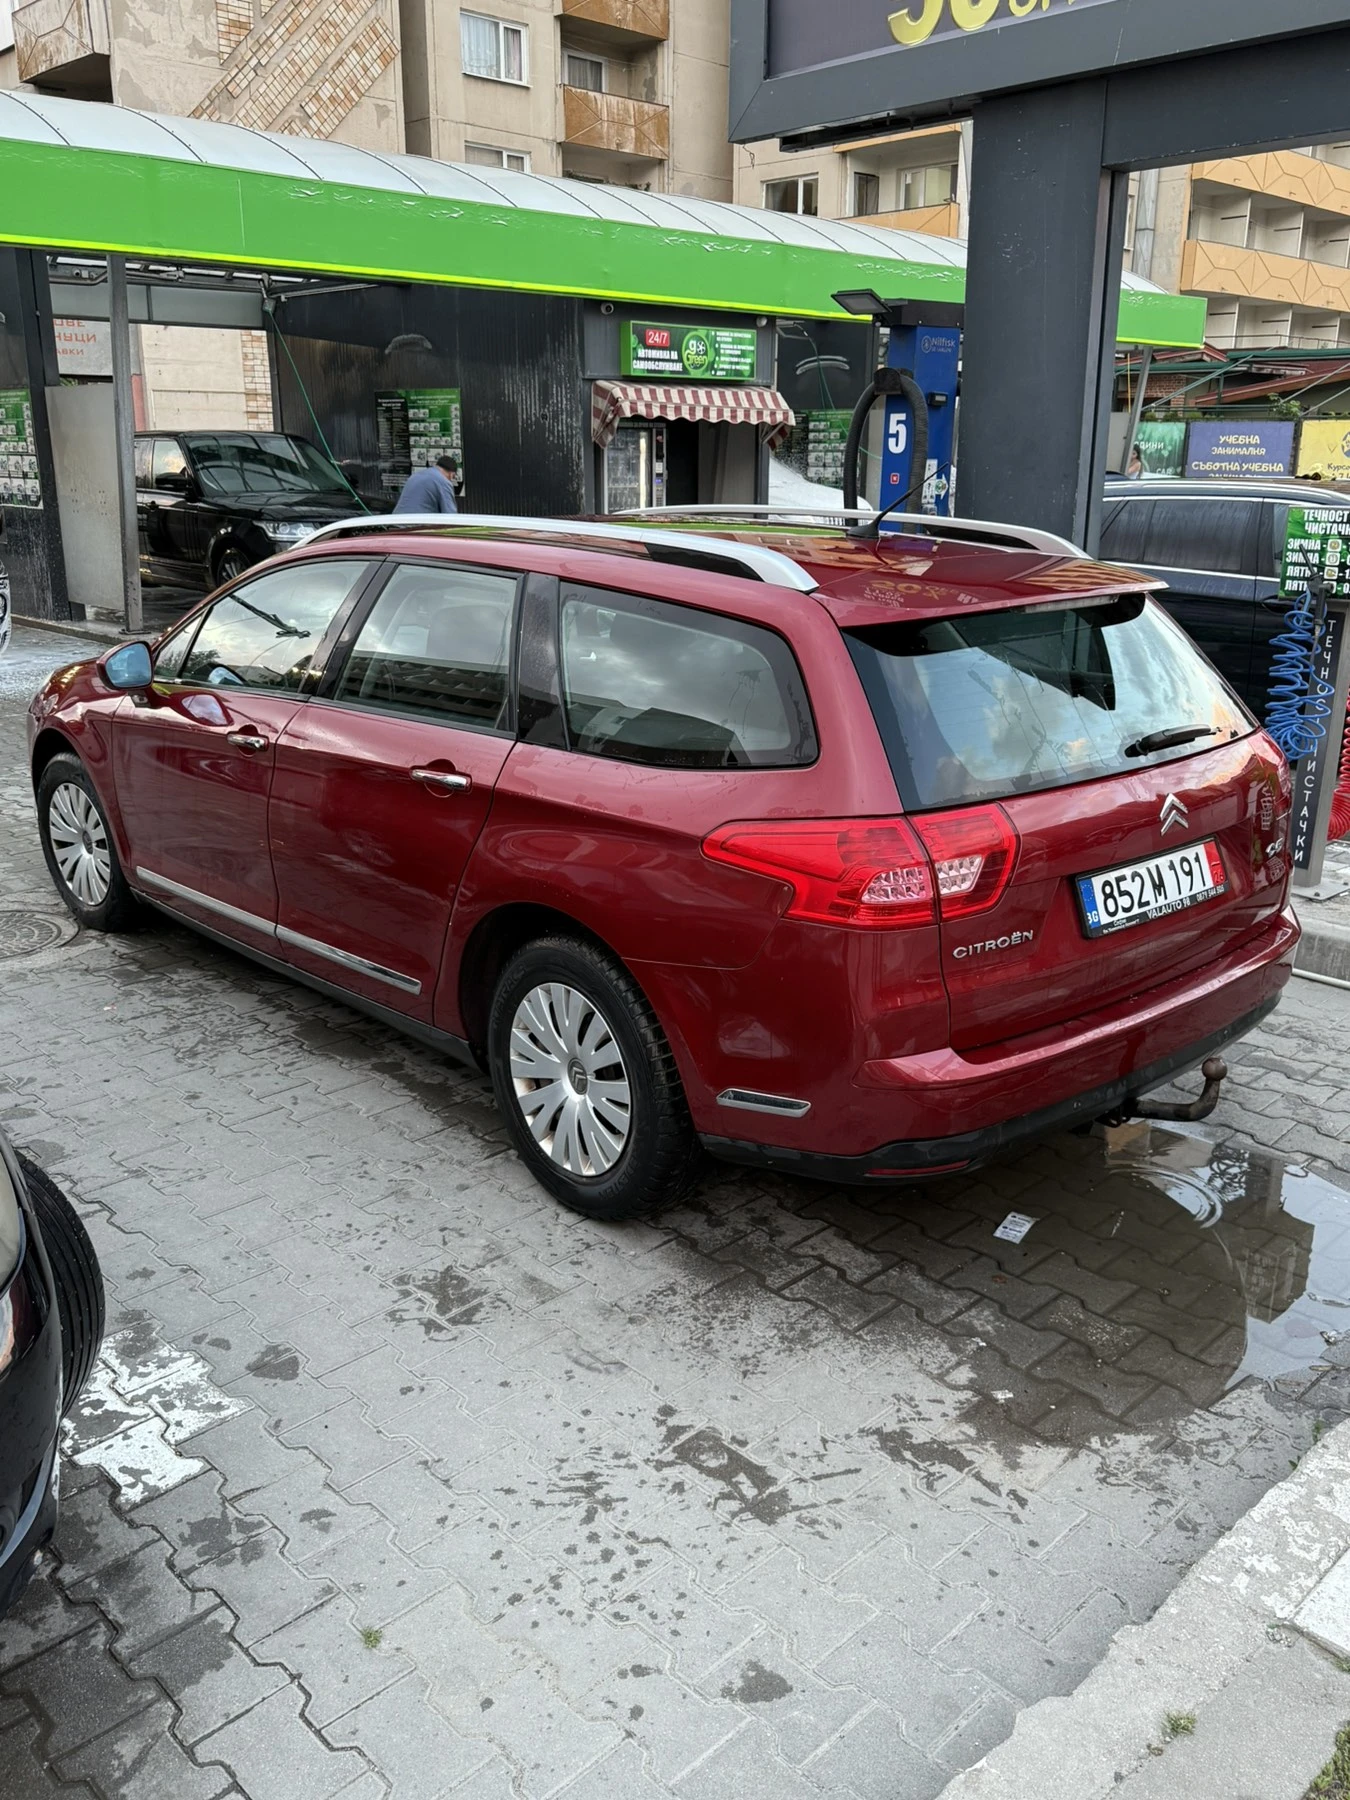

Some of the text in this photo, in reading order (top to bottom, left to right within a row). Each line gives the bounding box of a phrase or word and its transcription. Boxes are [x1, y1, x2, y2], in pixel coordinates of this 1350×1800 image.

[647, 331, 668, 345] 24/7
[931, 337, 956, 348] Nilfisk
[887, 412, 907, 454] 5
[1219, 434, 1260, 445] УЧЕБНА
[1211, 446, 1266, 456] ЗАНИМАЛНЯ
[1191, 461, 1284, 472] СЪБОТНА УЧЕБНА
[1303, 508, 1349, 522] ТЕЧНОСТ
[1287, 538, 1321, 550] ЗИМНА
[1146, 901, 1182, 920] VALAUTO
[952, 929, 1034, 959] CITROËN
